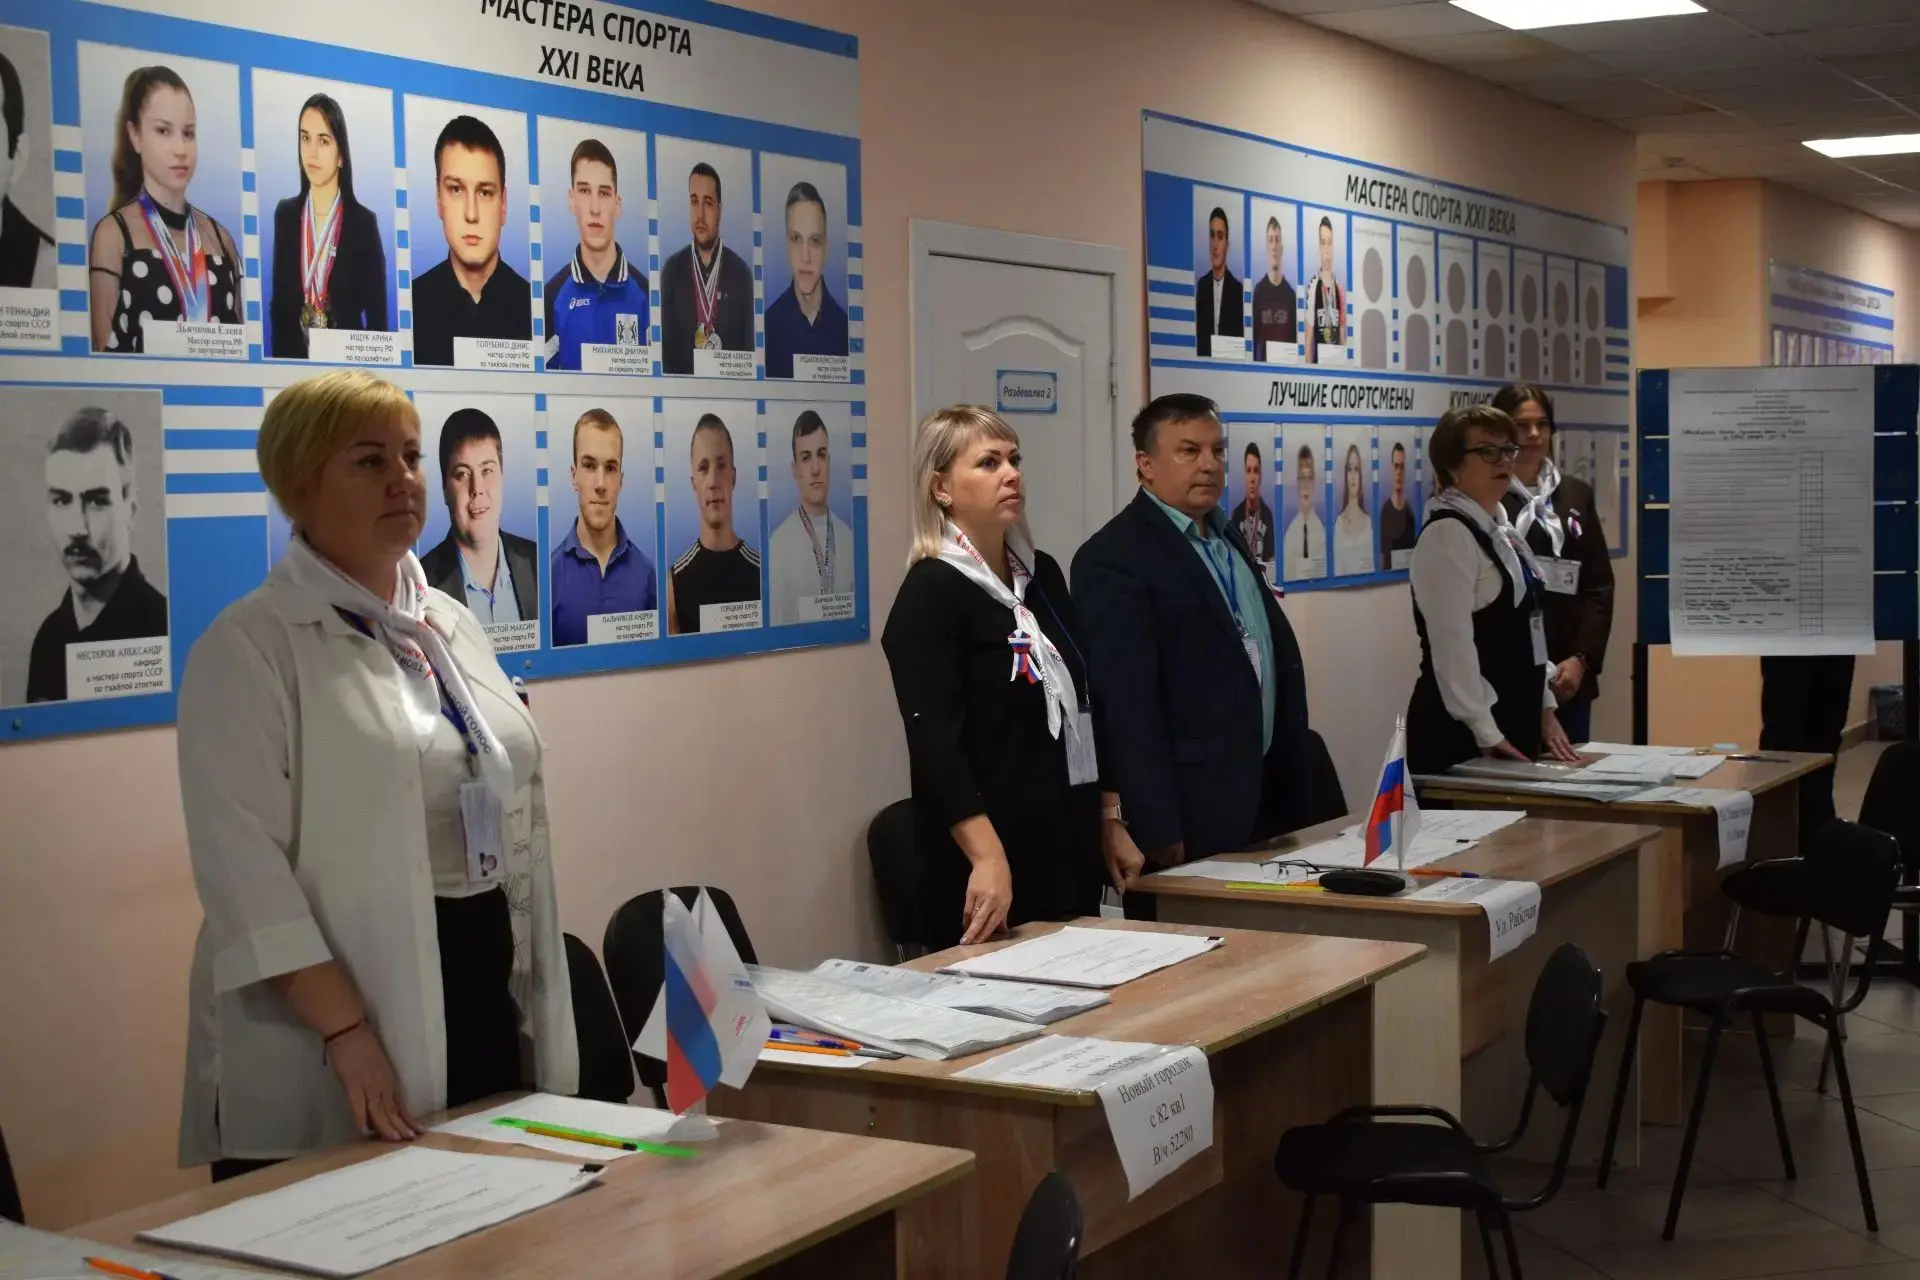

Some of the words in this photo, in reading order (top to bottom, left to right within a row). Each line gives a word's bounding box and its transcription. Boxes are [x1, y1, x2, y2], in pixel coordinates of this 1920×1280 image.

[481, 0, 595, 36] МАСТЕРА
[603, 12, 692, 56] СПОРТА
[586, 54, 645, 92] ВЕКА
[1346, 174, 1408, 213] МАСТЕРА
[1412, 190, 1461, 225] СПОРТА
[1488, 207, 1516, 238] ВЕКА
[1003, 385, 1046, 399] Раздевалка
[1046, 387, 1052, 399] 2
[1268, 380, 1328, 408] ЛУЧШИЕ
[1331, 383, 1415, 411] СПОРТСМЕНЫ
[483, 624, 509, 635] ОЛСТОЙ
[510, 623, 536, 632] МАКСИМ
[77, 648, 116, 661] НЕСТЕРОВ
[118, 645, 164, 658] АЛЕКСАНДР
[1118, 1074, 1156, 1104] Новый
[1153, 1055, 1193, 1087] городок
[1149, 1115, 1157, 1128] с
[1156, 1102, 1171, 1124] 82
